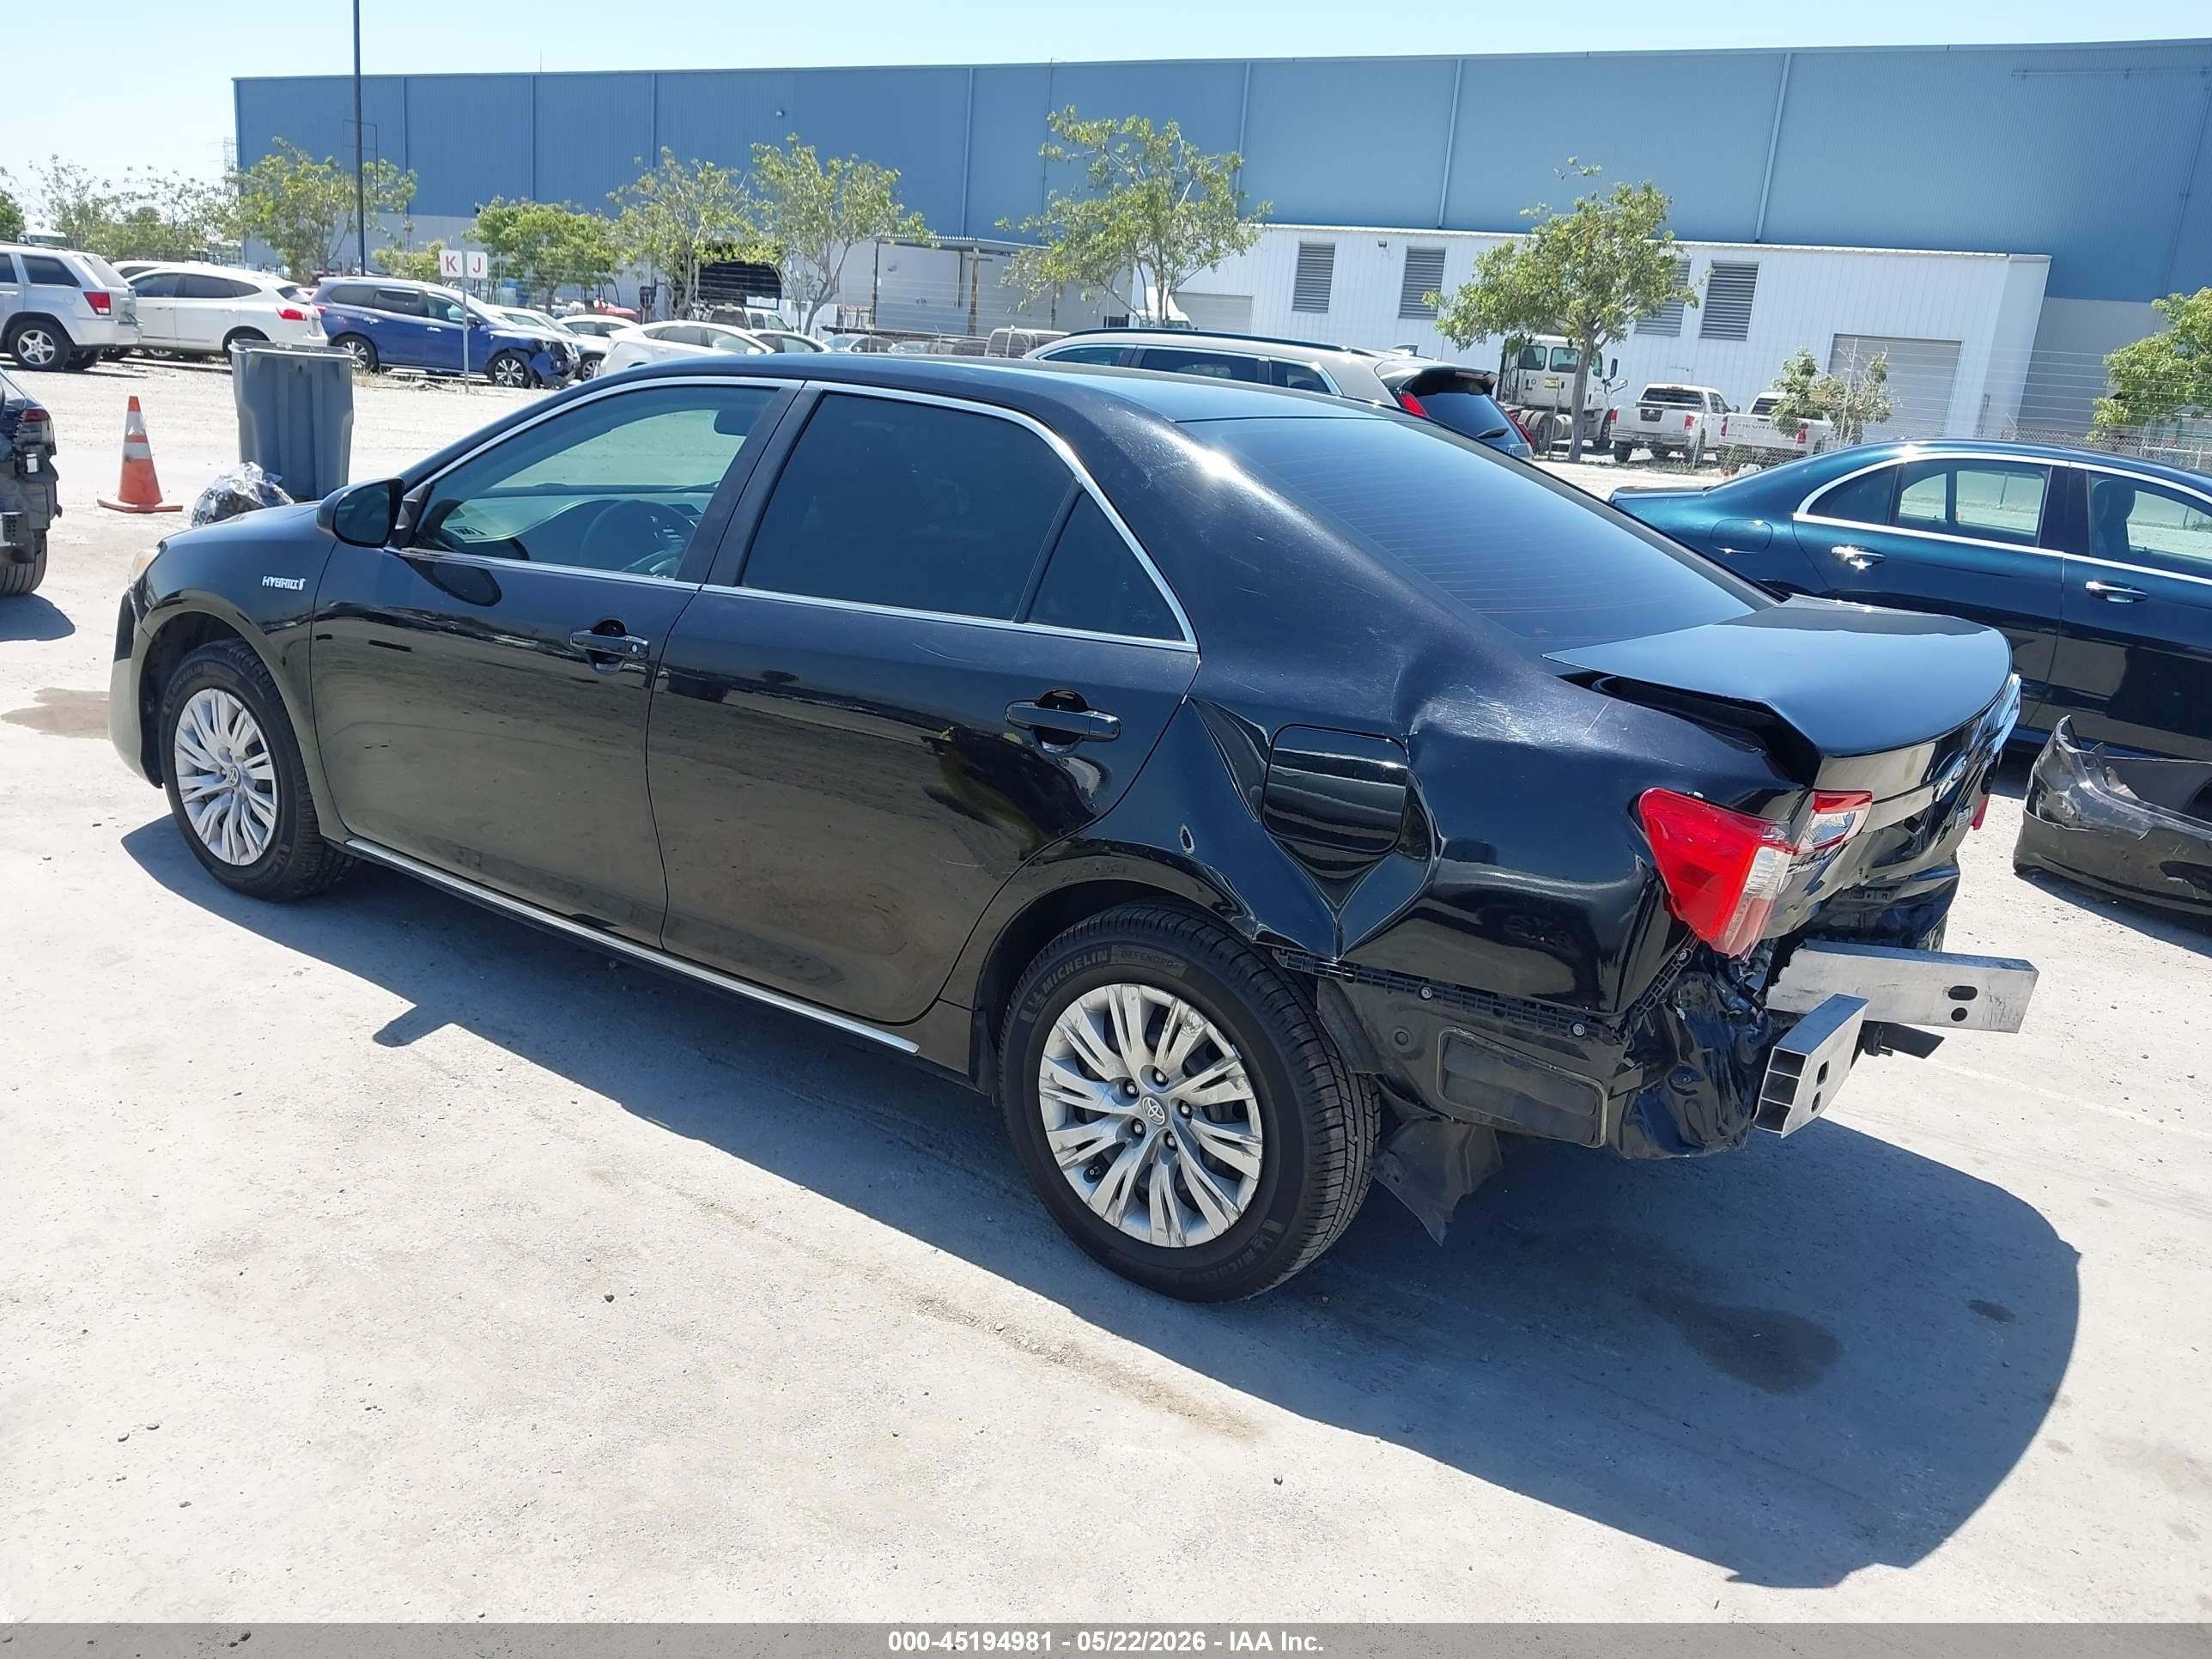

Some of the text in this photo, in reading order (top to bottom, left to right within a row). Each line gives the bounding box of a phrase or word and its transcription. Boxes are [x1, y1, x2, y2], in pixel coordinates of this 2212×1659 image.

[445, 254, 459, 272] K
[472, 257, 482, 274] J
[261, 574, 299, 590] HYBRID
[1041, 949, 1109, 994] MICHELIN
